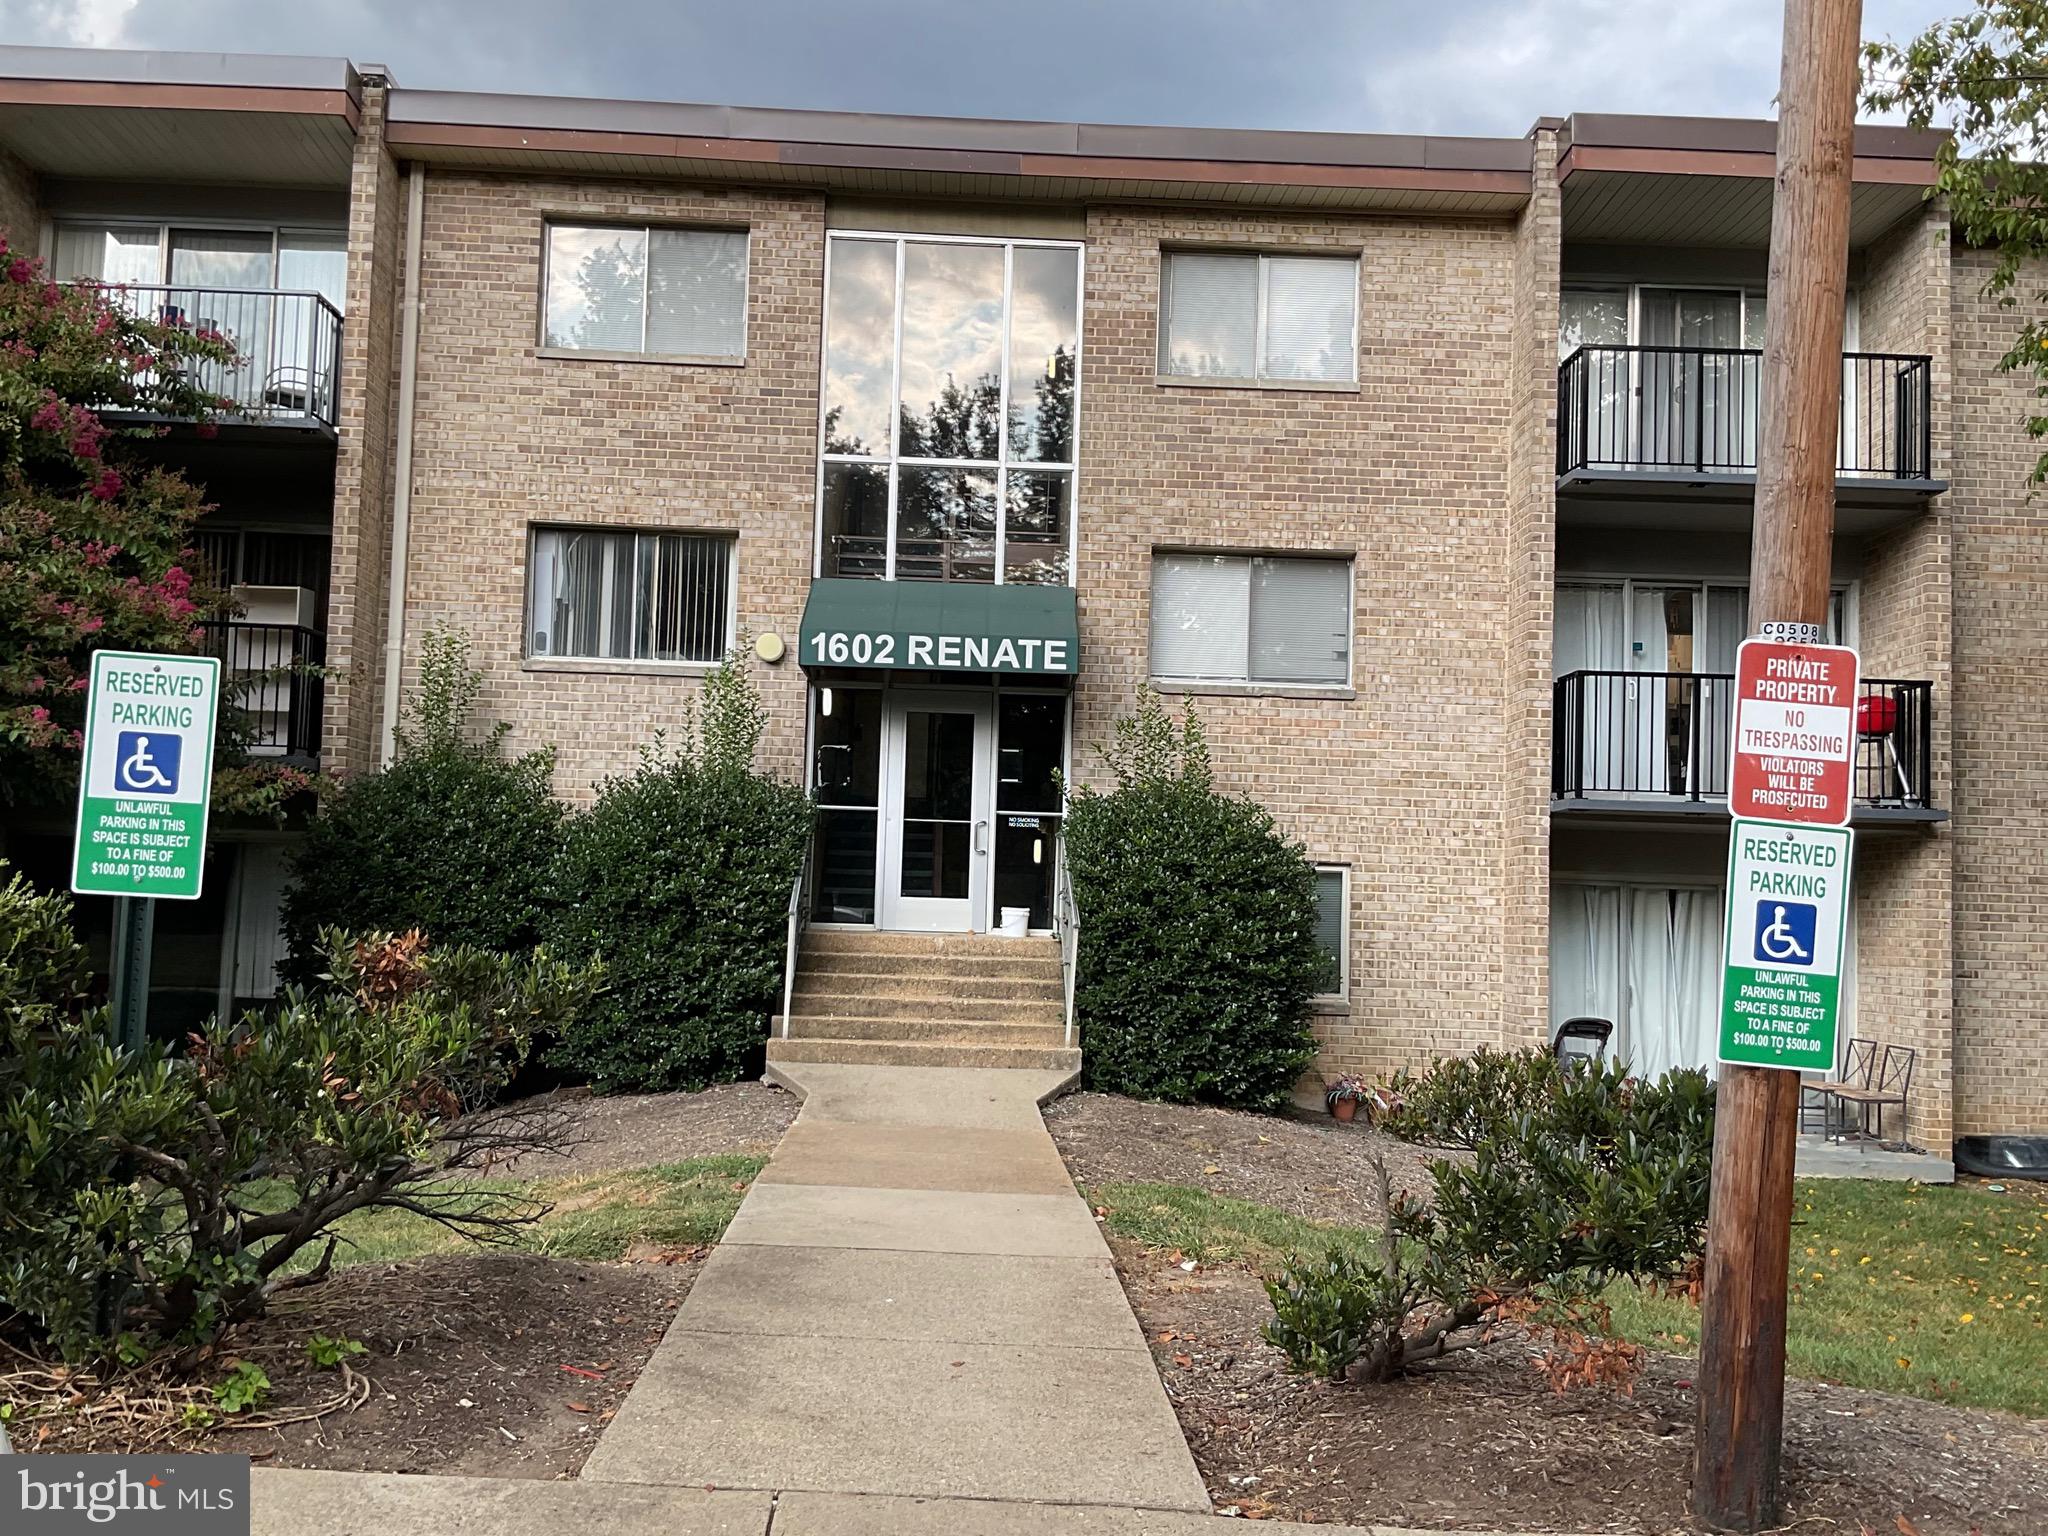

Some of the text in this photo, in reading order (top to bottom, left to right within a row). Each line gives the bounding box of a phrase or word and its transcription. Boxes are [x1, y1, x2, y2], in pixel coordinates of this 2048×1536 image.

[811, 632, 1067, 670] 1602 RENATE
[1766, 658, 1829, 681] PRIVATE
[106, 671, 203, 697] RESERVED
[1756, 679, 1837, 704] PROPERTY
[112, 702, 192, 728] PARKING
[1785, 710, 1805, 728] NO
[1745, 729, 1843, 753] TRESPASSING
[1760, 757, 1824, 776] VIOLATORS
[1768, 774, 1815, 791] WILL BE
[115, 801, 173, 816] UNLAWFUL
[1752, 789, 1828, 809] PROSECUTED
[100, 815, 186, 832] PARKING IN THIS
[92, 831, 190, 848] SPACE IS SUBJECT
[106, 847, 174, 862] TO A FINE OF
[1744, 838, 1837, 868] RESERVED
[91, 861, 185, 879] $100.00 TO $500.00
[1750, 870, 1826, 898] PARKING
[1755, 971, 1809, 987] UNLAWFUL
[1741, 986, 1821, 1003] PARKING IN THIS
[1734, 1001, 1825, 1020] SPACE IS SUBJECT
[1748, 1018, 1810, 1034] TO A FINE OF
[1733, 1033, 1821, 1052] $100.00 TO $500.00
